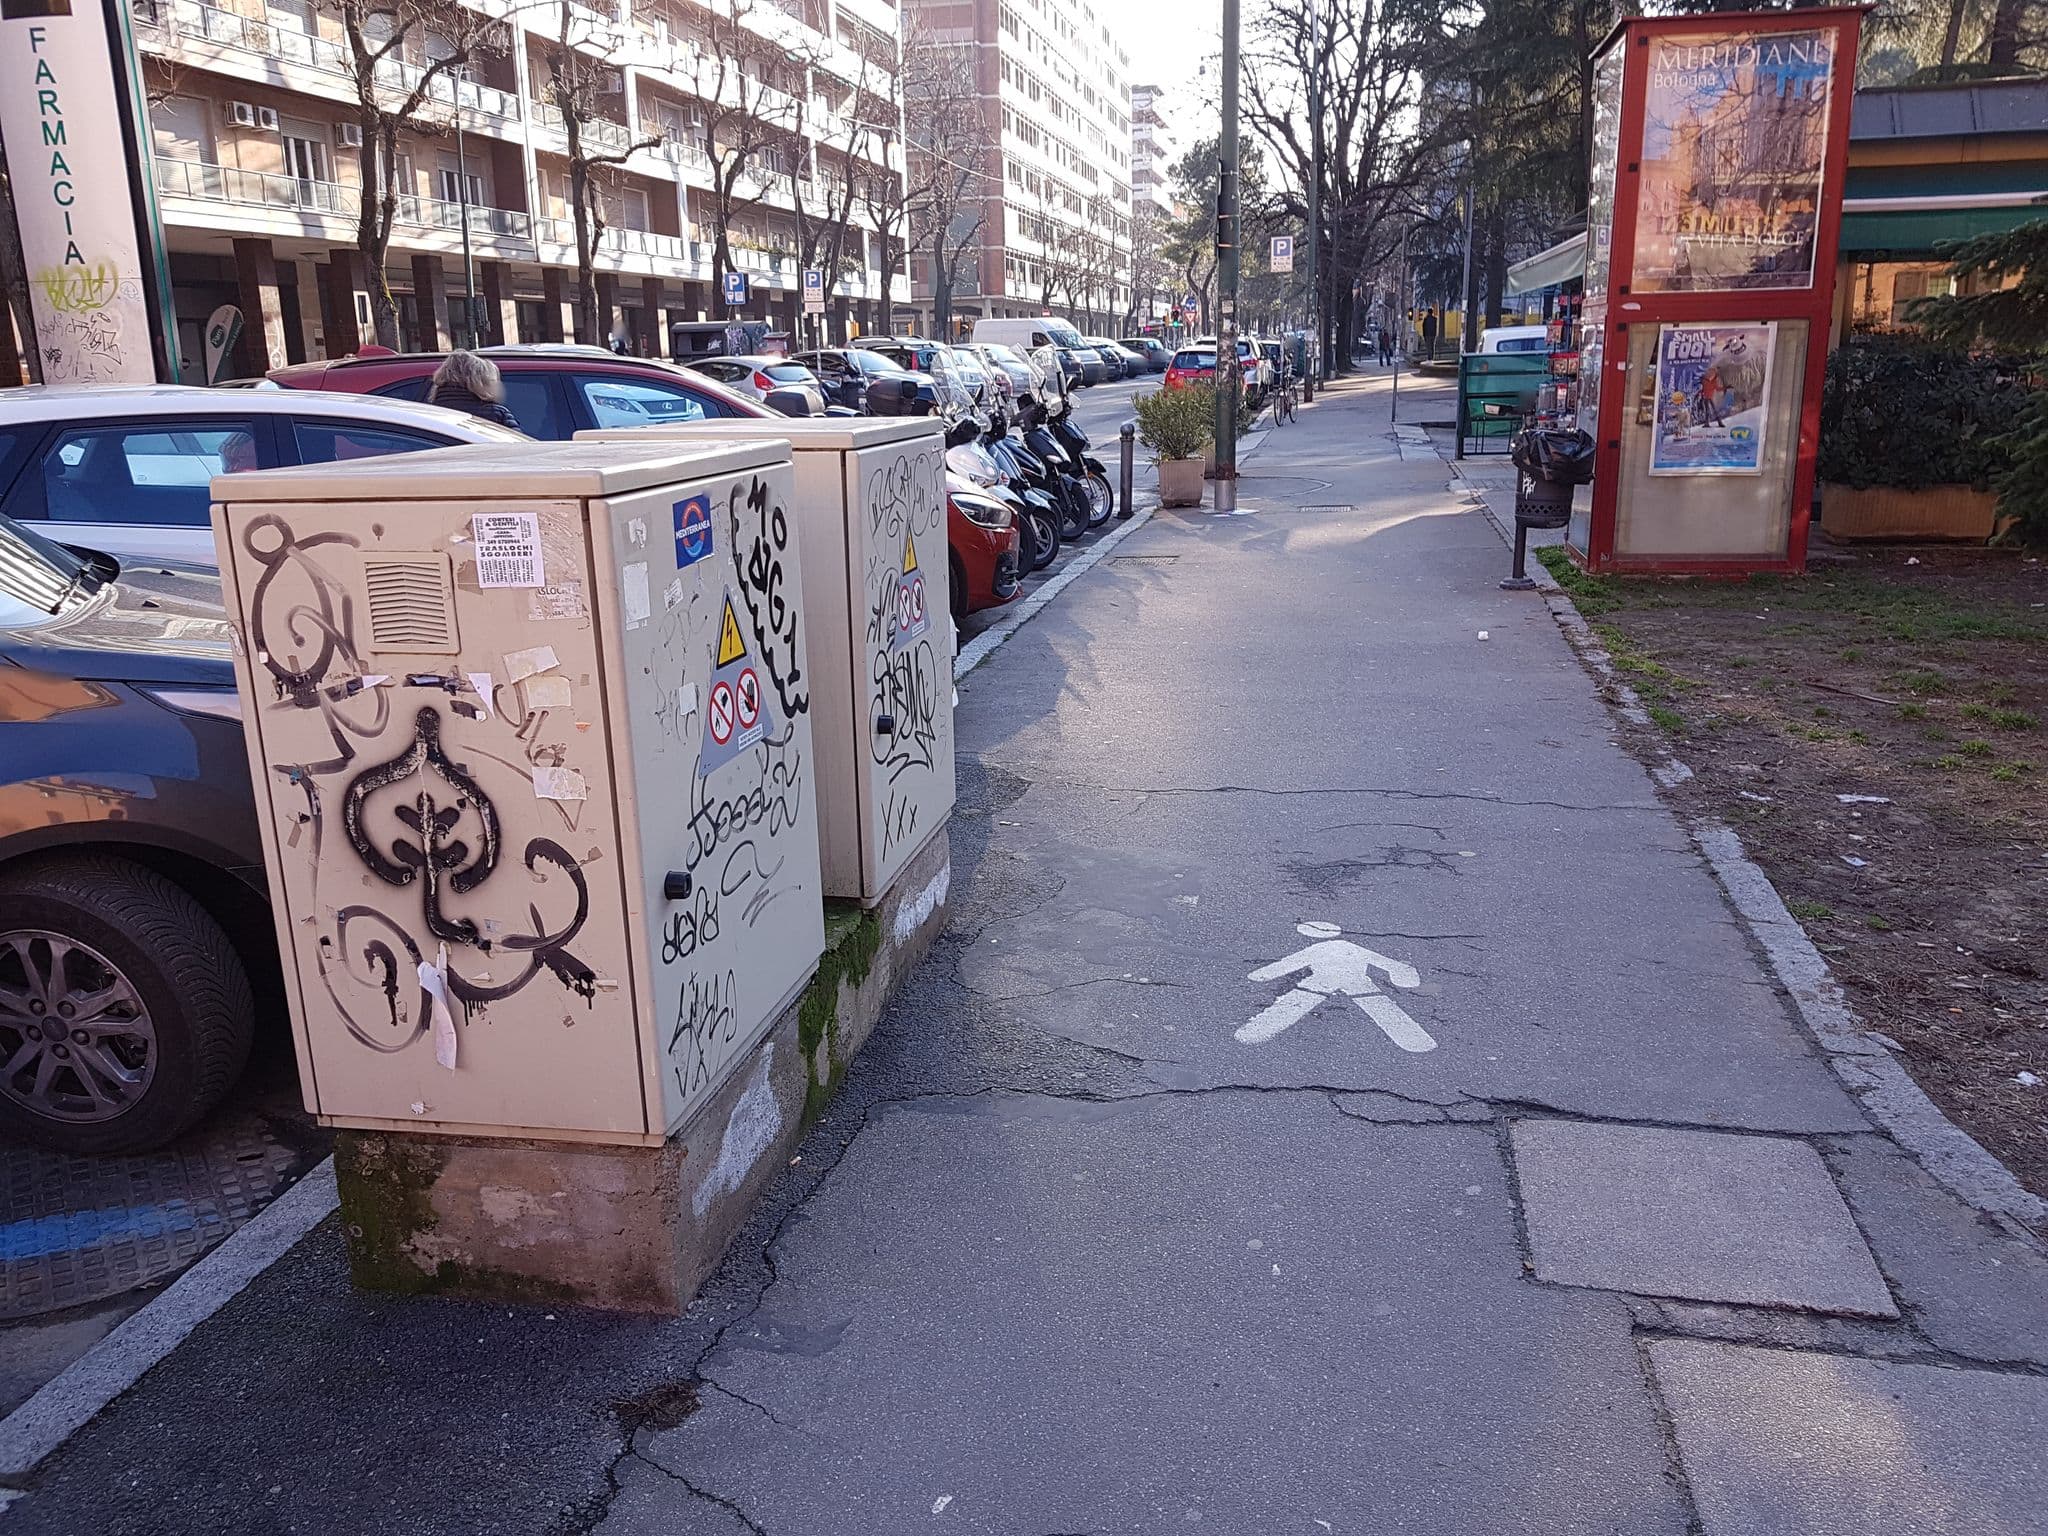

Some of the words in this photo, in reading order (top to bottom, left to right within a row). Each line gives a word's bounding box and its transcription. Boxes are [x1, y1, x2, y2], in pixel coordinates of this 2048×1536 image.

[1656, 39, 1820, 72] MERIDIANI
[1654, 71, 1716, 89] Bologna
[29, 27, 85, 265] FARMACIA
[1276, 240, 1287, 255] P
[728, 274, 740, 291] P
[808, 273, 817, 287] P
[1673, 330, 1716, 343] SMALL
[1668, 342, 1713, 360] FOOT
[675, 519, 711, 540] MEDITERRANEA
